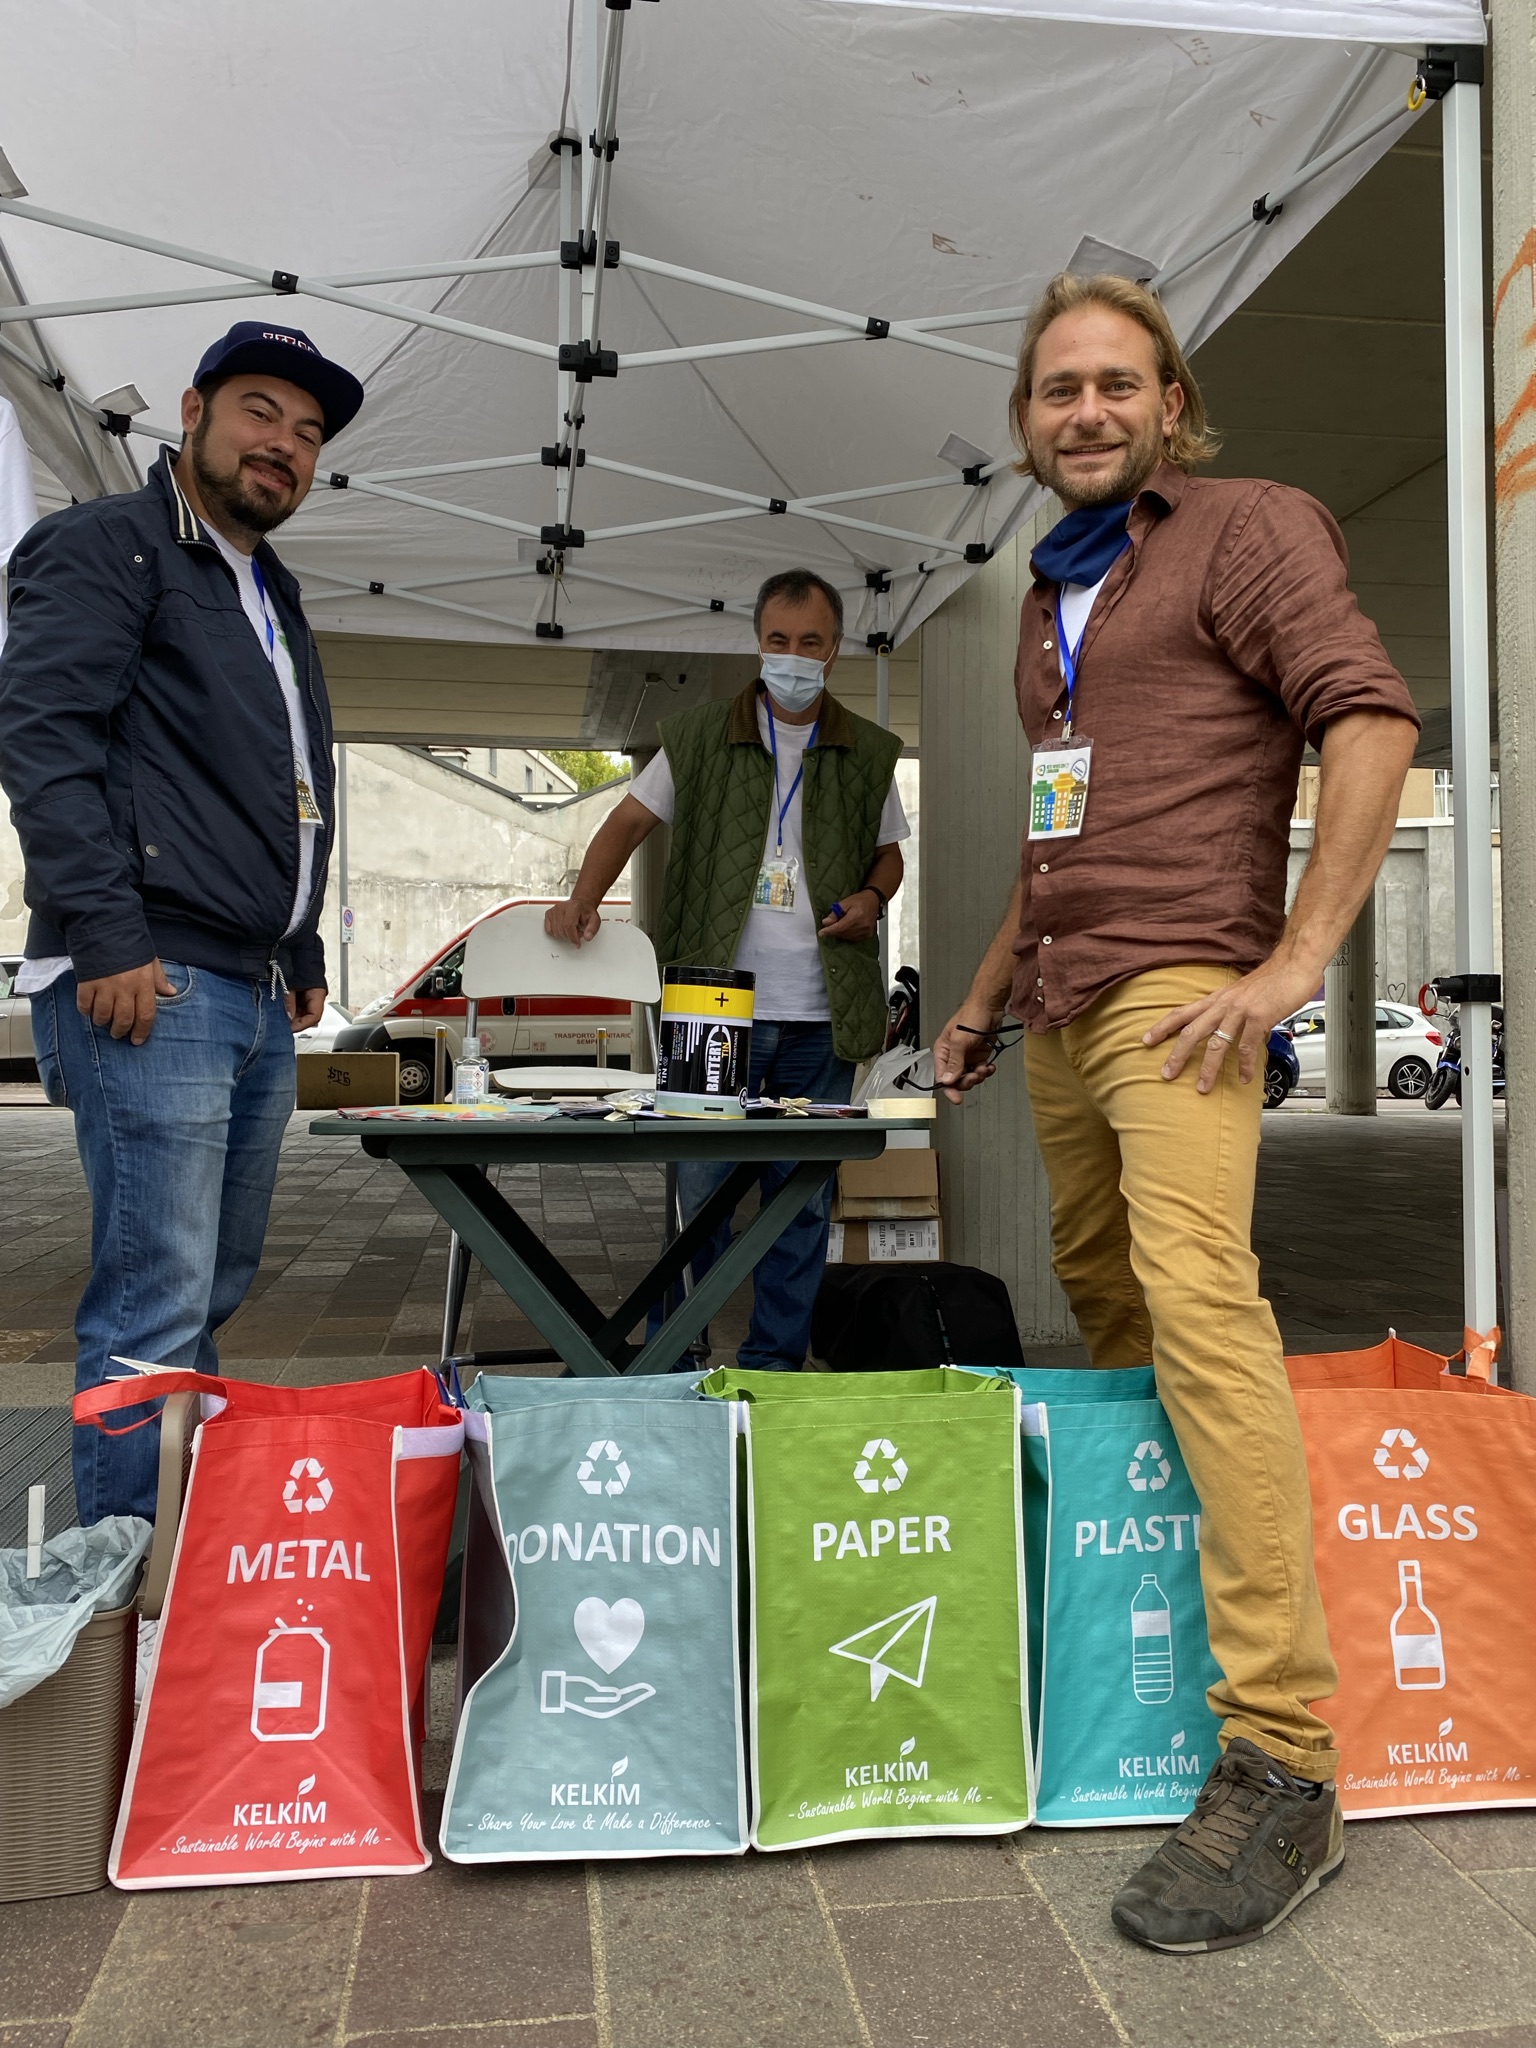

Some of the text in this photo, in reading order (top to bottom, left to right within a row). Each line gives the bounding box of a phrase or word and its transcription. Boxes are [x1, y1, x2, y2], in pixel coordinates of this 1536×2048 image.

[706, 1040, 721, 1091] BATTERY
[721, 1042, 729, 1058] TIN
[813, 1515, 952, 1561] PAPER
[1075, 1514, 1200, 1557] PLASTI
[1338, 1503, 1478, 1541] GLASS
[227, 1539, 371, 1584] METAL
[1071, 1784, 1128, 1803] Sustainable
[1133, 1782, 1166, 1800] World
[1344, 1766, 1521, 1790] Sustainable World Begins with Me
[797, 1786, 982, 1820] Sustainable World Begins with Me
[171, 1827, 380, 1855] Sustainable World Begins with Me
[478, 1812, 711, 1836] Share Your Love & Make a Difference
